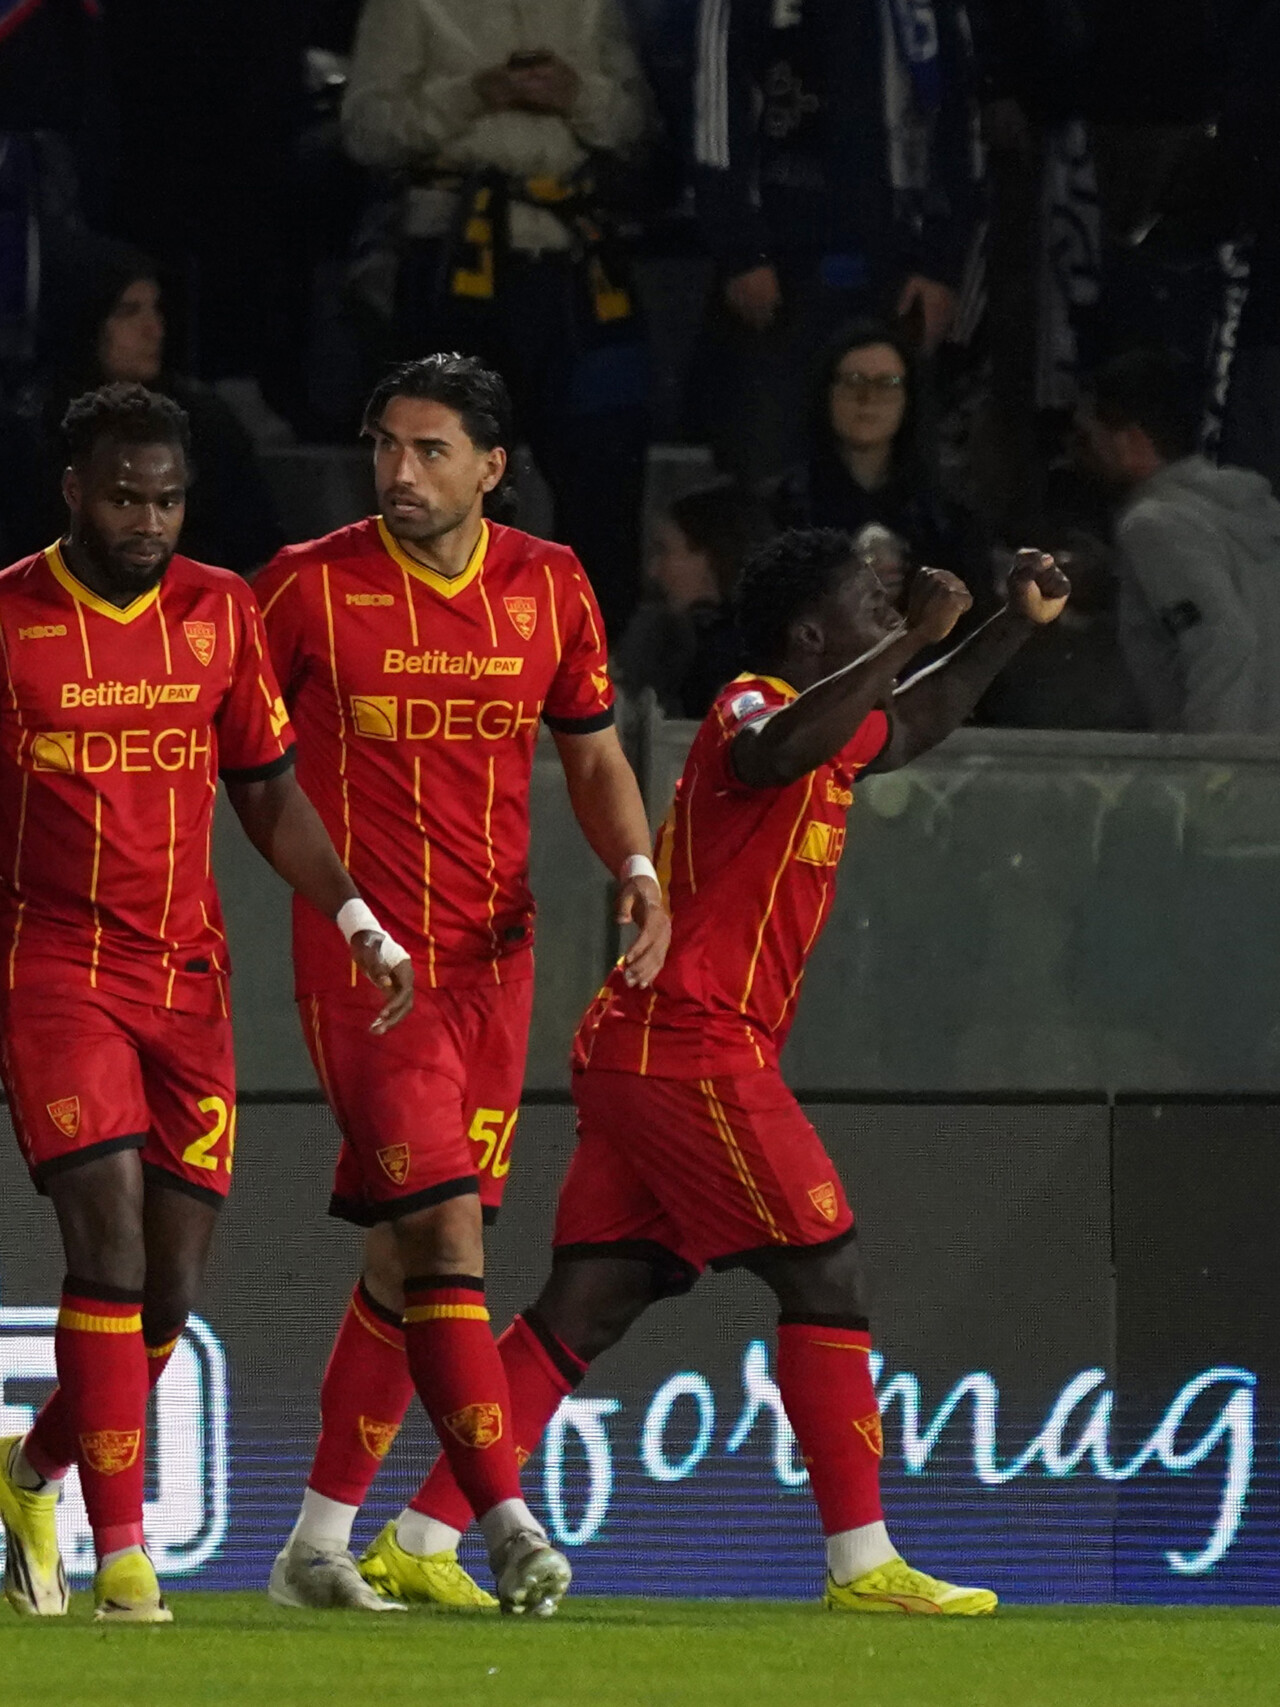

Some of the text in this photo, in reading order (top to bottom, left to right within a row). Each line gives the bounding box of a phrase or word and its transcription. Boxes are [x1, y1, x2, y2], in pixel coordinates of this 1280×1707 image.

[383, 648, 487, 680] Betitaly
[60, 678, 162, 709] Betitaly
[182, 1095, 237, 1176] 2
